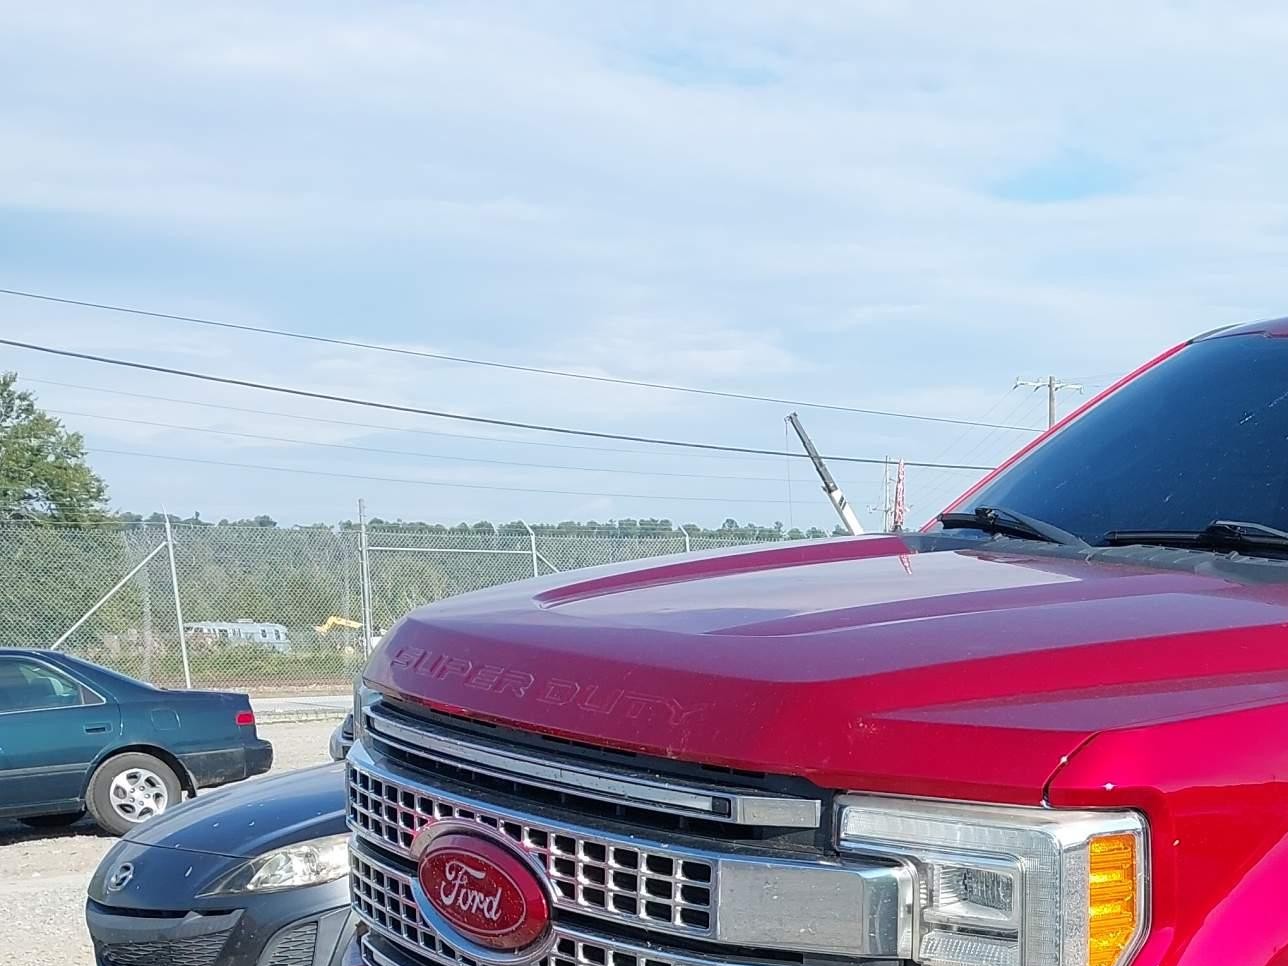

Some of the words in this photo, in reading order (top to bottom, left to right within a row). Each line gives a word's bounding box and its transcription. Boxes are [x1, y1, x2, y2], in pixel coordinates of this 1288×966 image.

[390, 647, 535, 698] SUPER
[536, 677, 705, 726] DUTY
[440, 860, 502, 921] Ford
